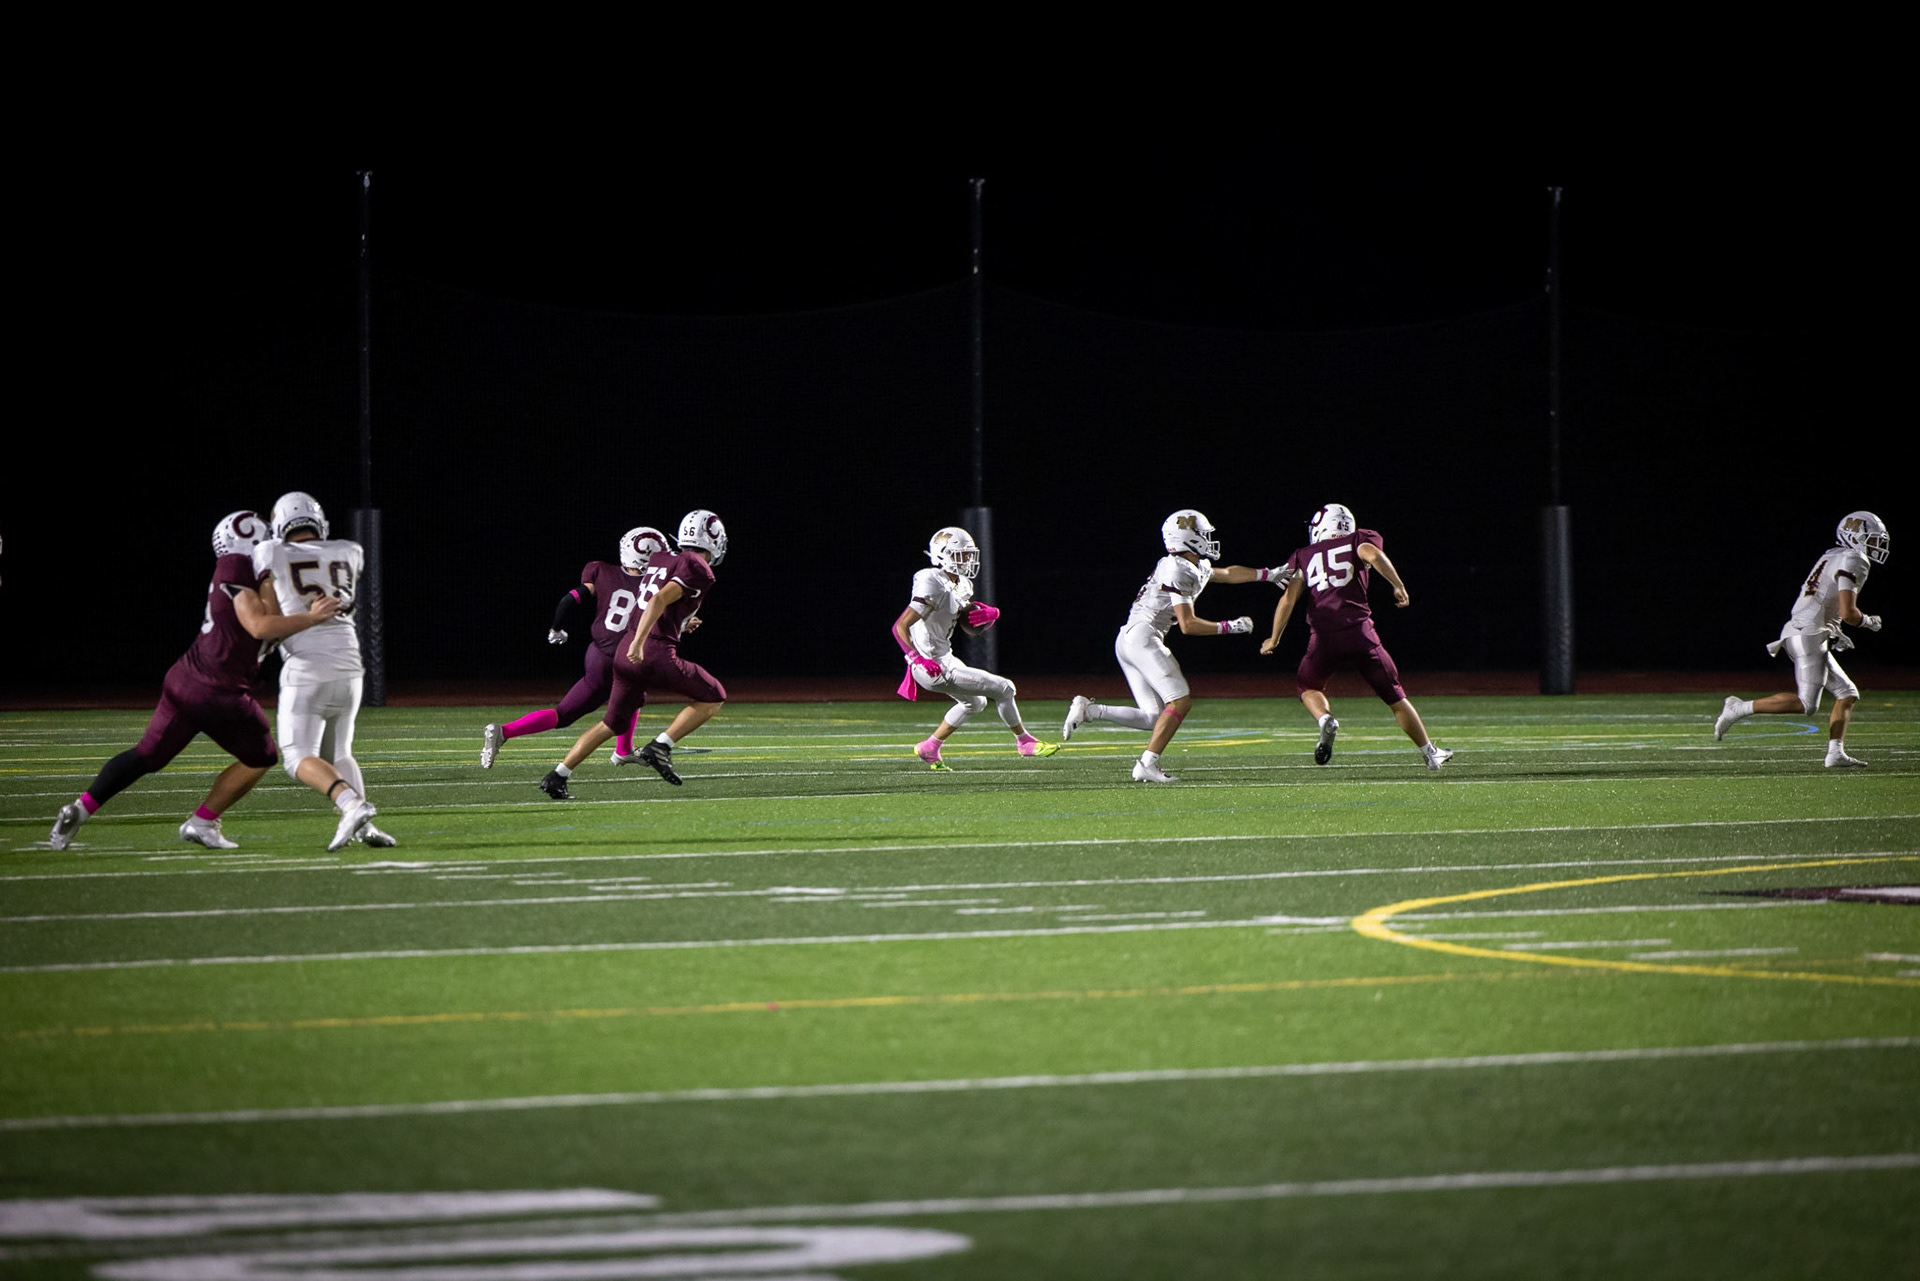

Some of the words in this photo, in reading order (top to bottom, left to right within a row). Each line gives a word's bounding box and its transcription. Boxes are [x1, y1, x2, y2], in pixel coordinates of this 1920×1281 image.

[1176, 515, 1197, 530] M
[1337, 521, 1350, 531] 45
[683, 526, 695, 537] 56
[1306, 543, 1355, 592] 45
[289, 561, 353, 604] 50
